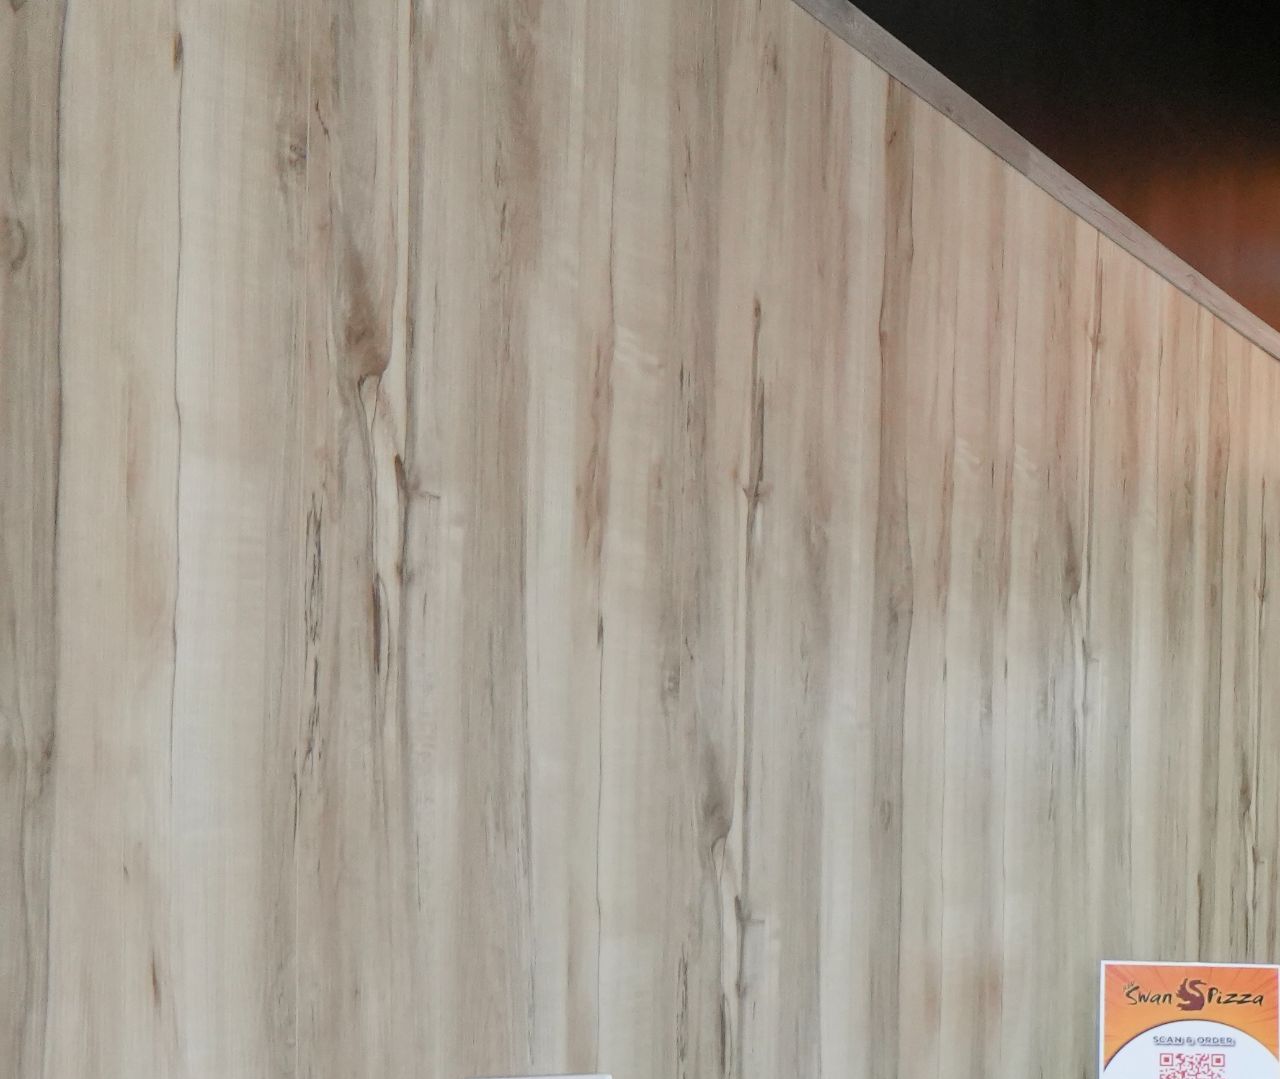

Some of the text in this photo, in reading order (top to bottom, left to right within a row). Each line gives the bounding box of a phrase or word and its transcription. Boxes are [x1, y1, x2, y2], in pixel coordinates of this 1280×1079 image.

[1126, 986, 1264, 1006] Swan Pizza
[1153, 1036, 1183, 1045] SCAN
[1197, 1037, 1235, 1047] ORDER
